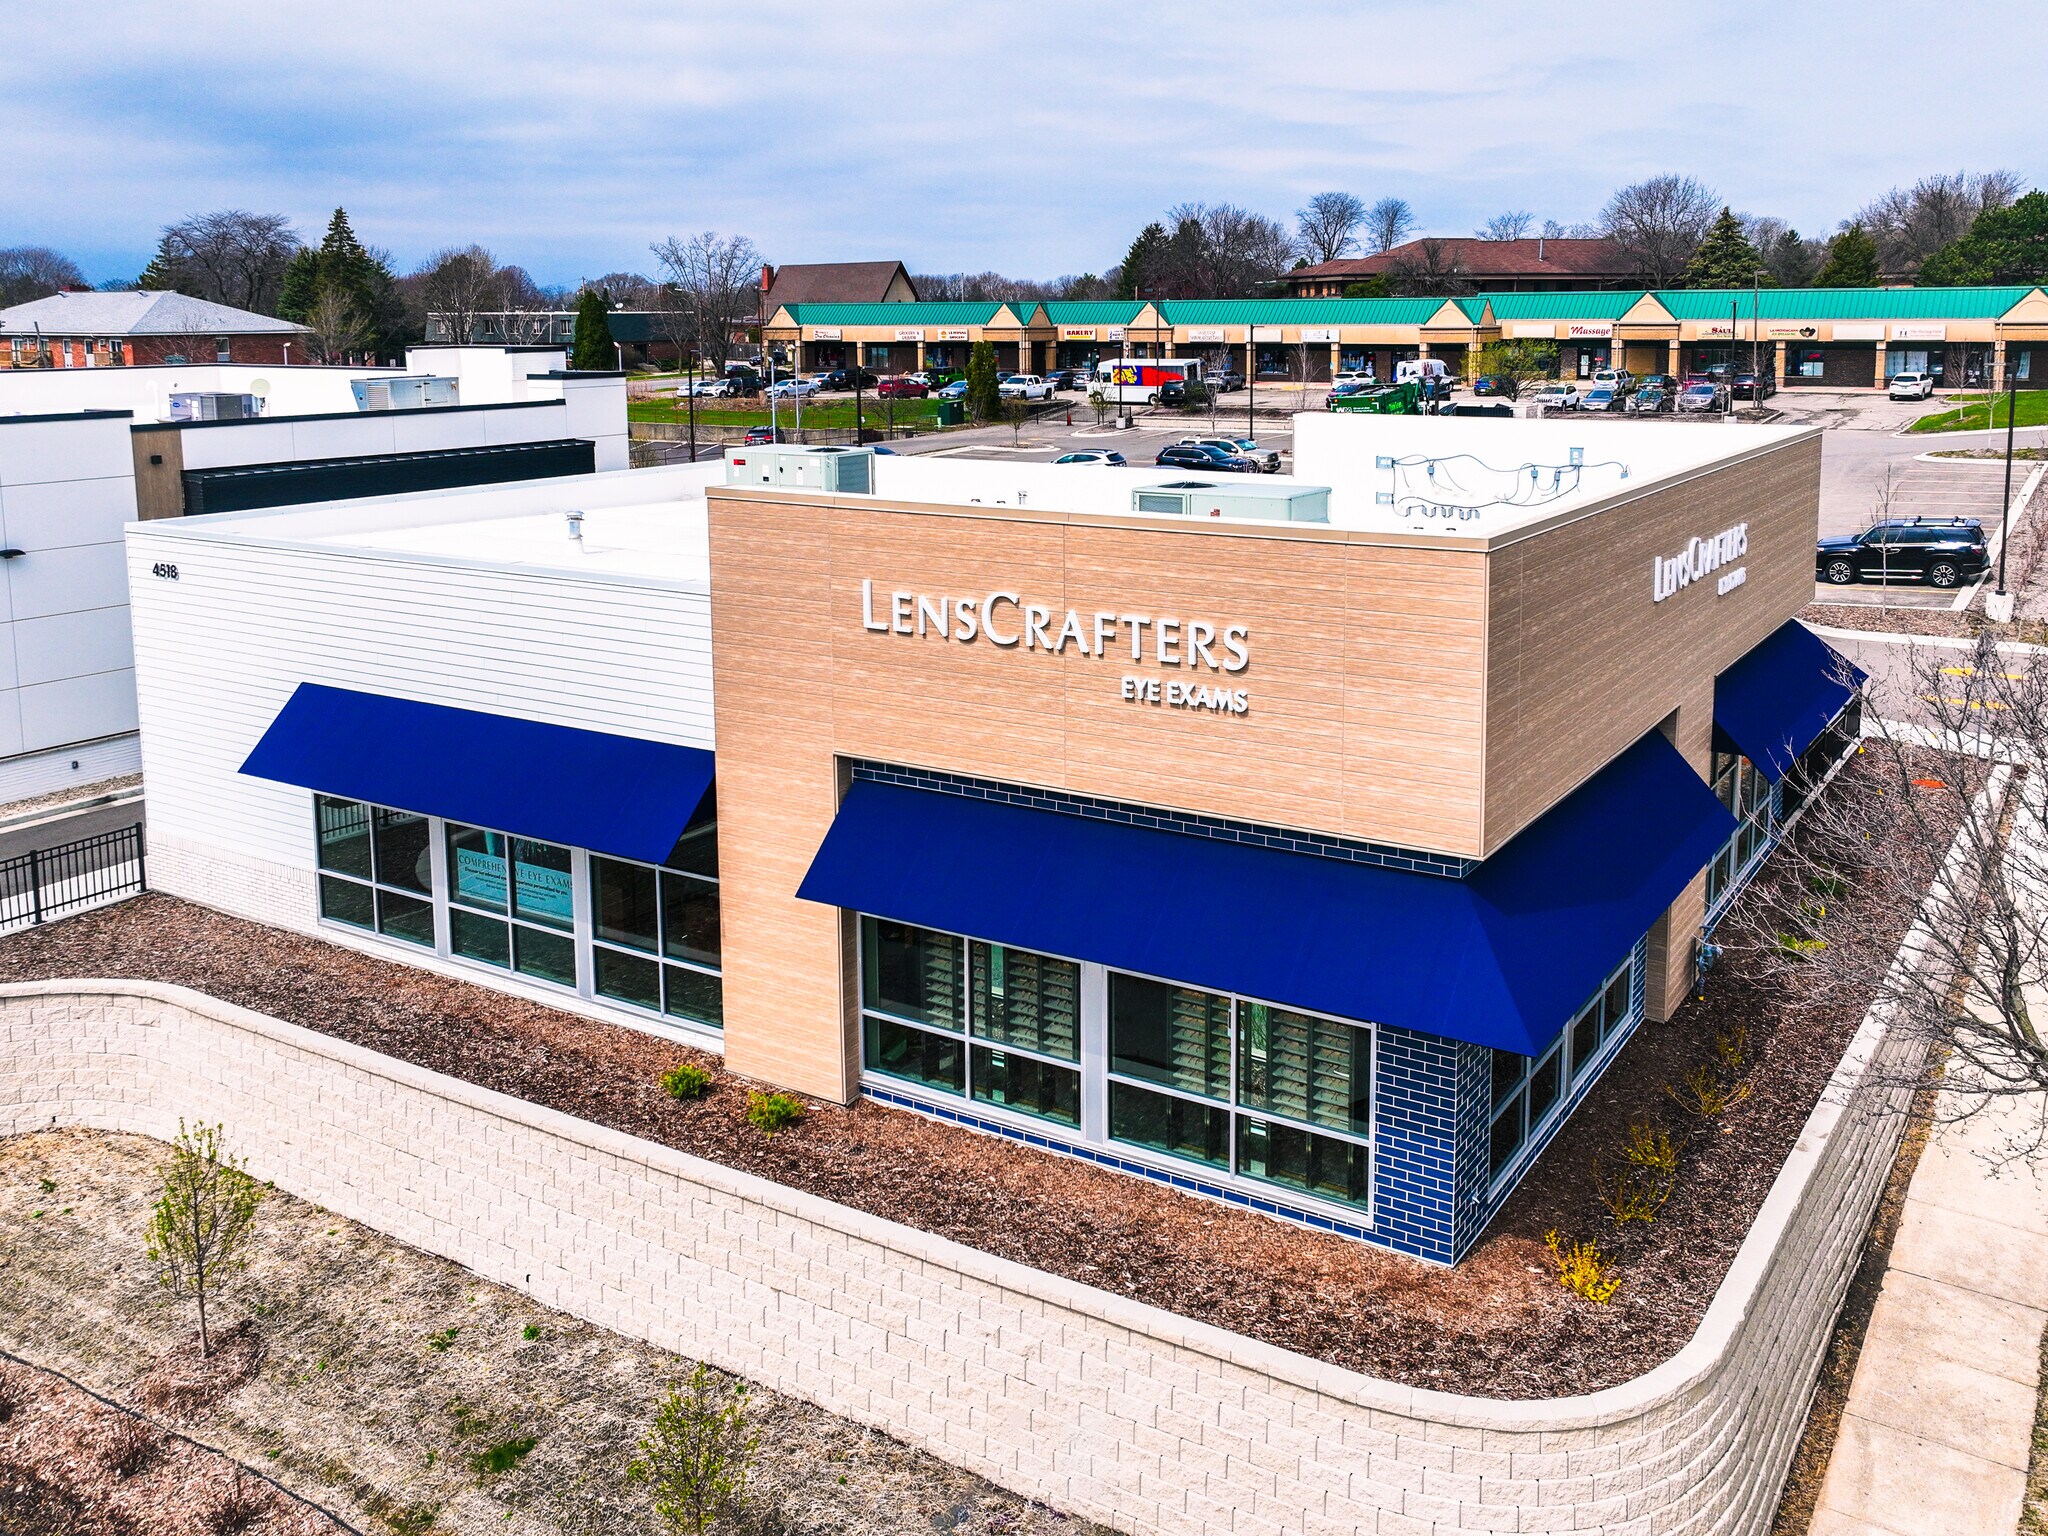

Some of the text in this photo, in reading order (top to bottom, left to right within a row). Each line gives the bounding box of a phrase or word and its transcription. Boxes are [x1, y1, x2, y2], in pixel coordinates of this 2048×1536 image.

[1571, 326, 1611, 336] Massage
[152, 562, 178, 579] 4518
[1121, 675, 1249, 714] EYE EXAMS
[528, 870, 542, 882] EYE
